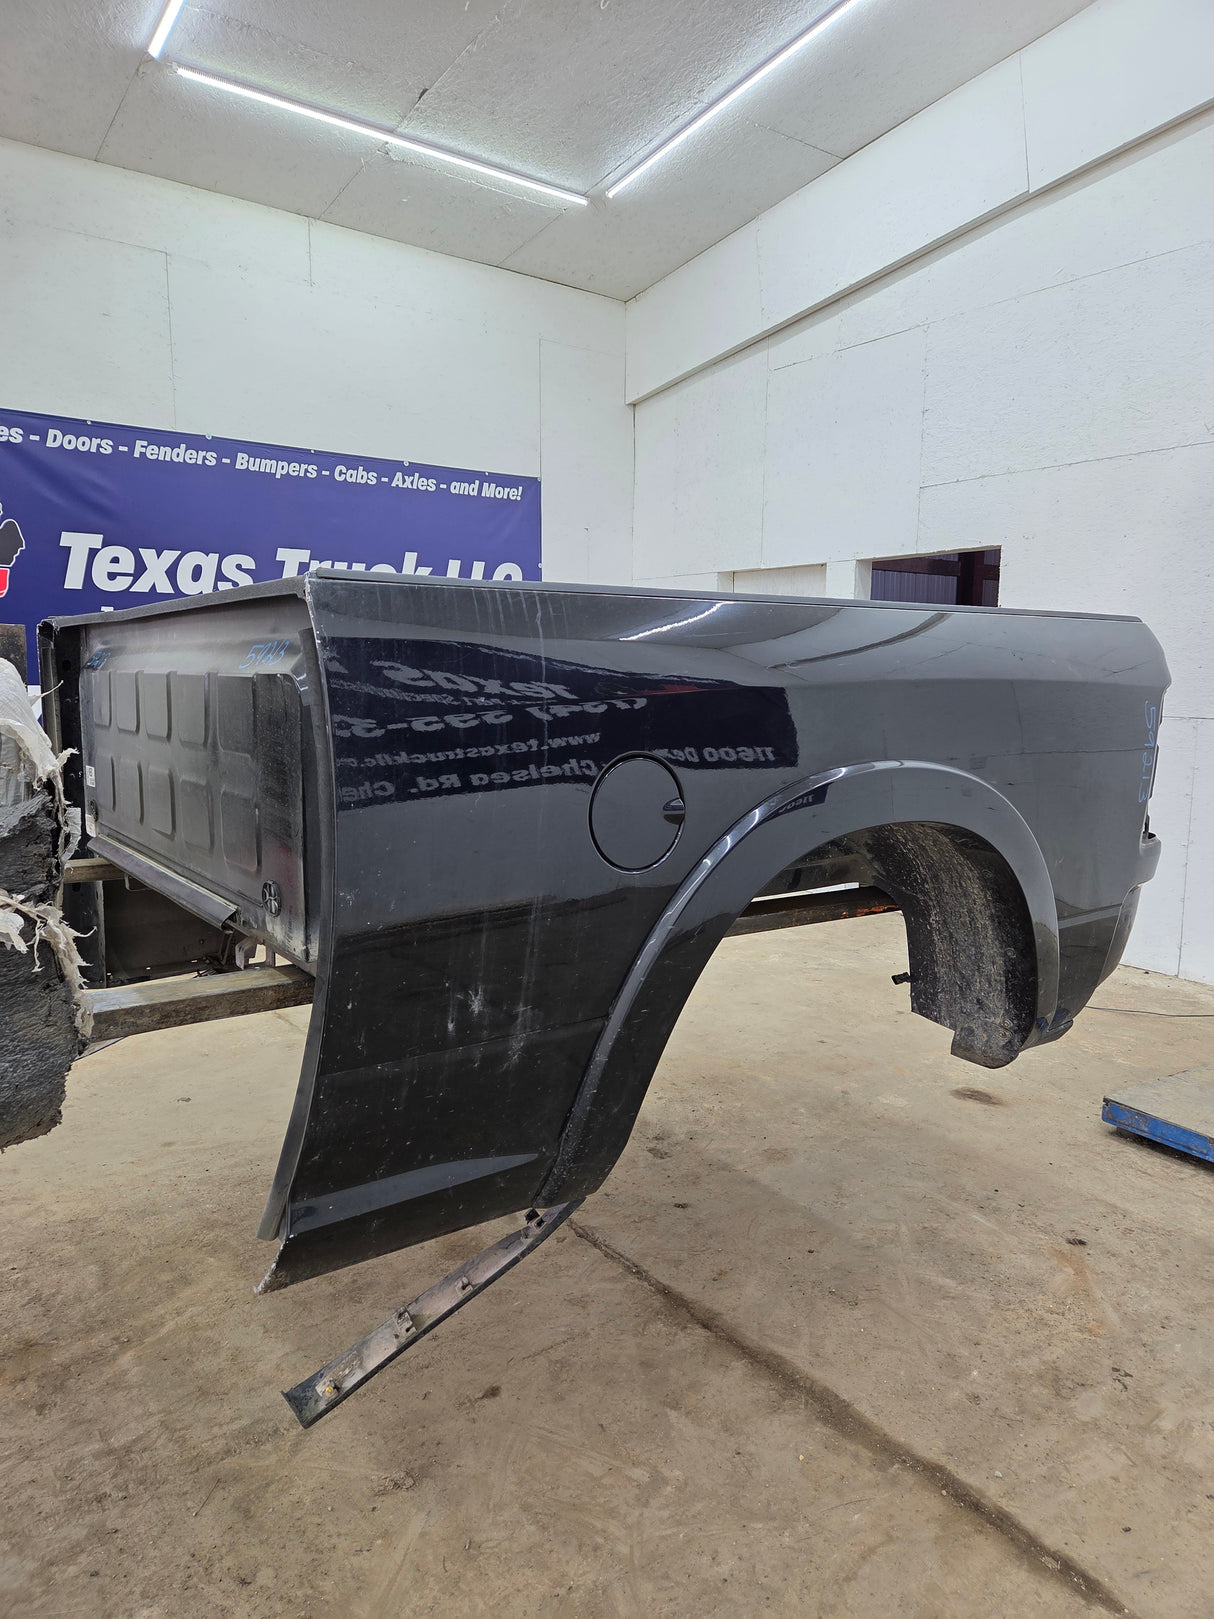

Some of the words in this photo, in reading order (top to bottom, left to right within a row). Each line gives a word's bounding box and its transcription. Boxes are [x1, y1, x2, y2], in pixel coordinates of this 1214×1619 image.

[0, 425, 23, 443] es
[46, 429, 114, 454] Doors
[134, 440, 217, 466] Fenders
[235, 453, 317, 478] Bumpers
[334, 465, 377, 484] Cabs
[391, 472, 437, 491] Axles
[450, 480, 479, 497] and
[481, 482, 523, 501] More!
[59, 531, 256, 596] Texas
